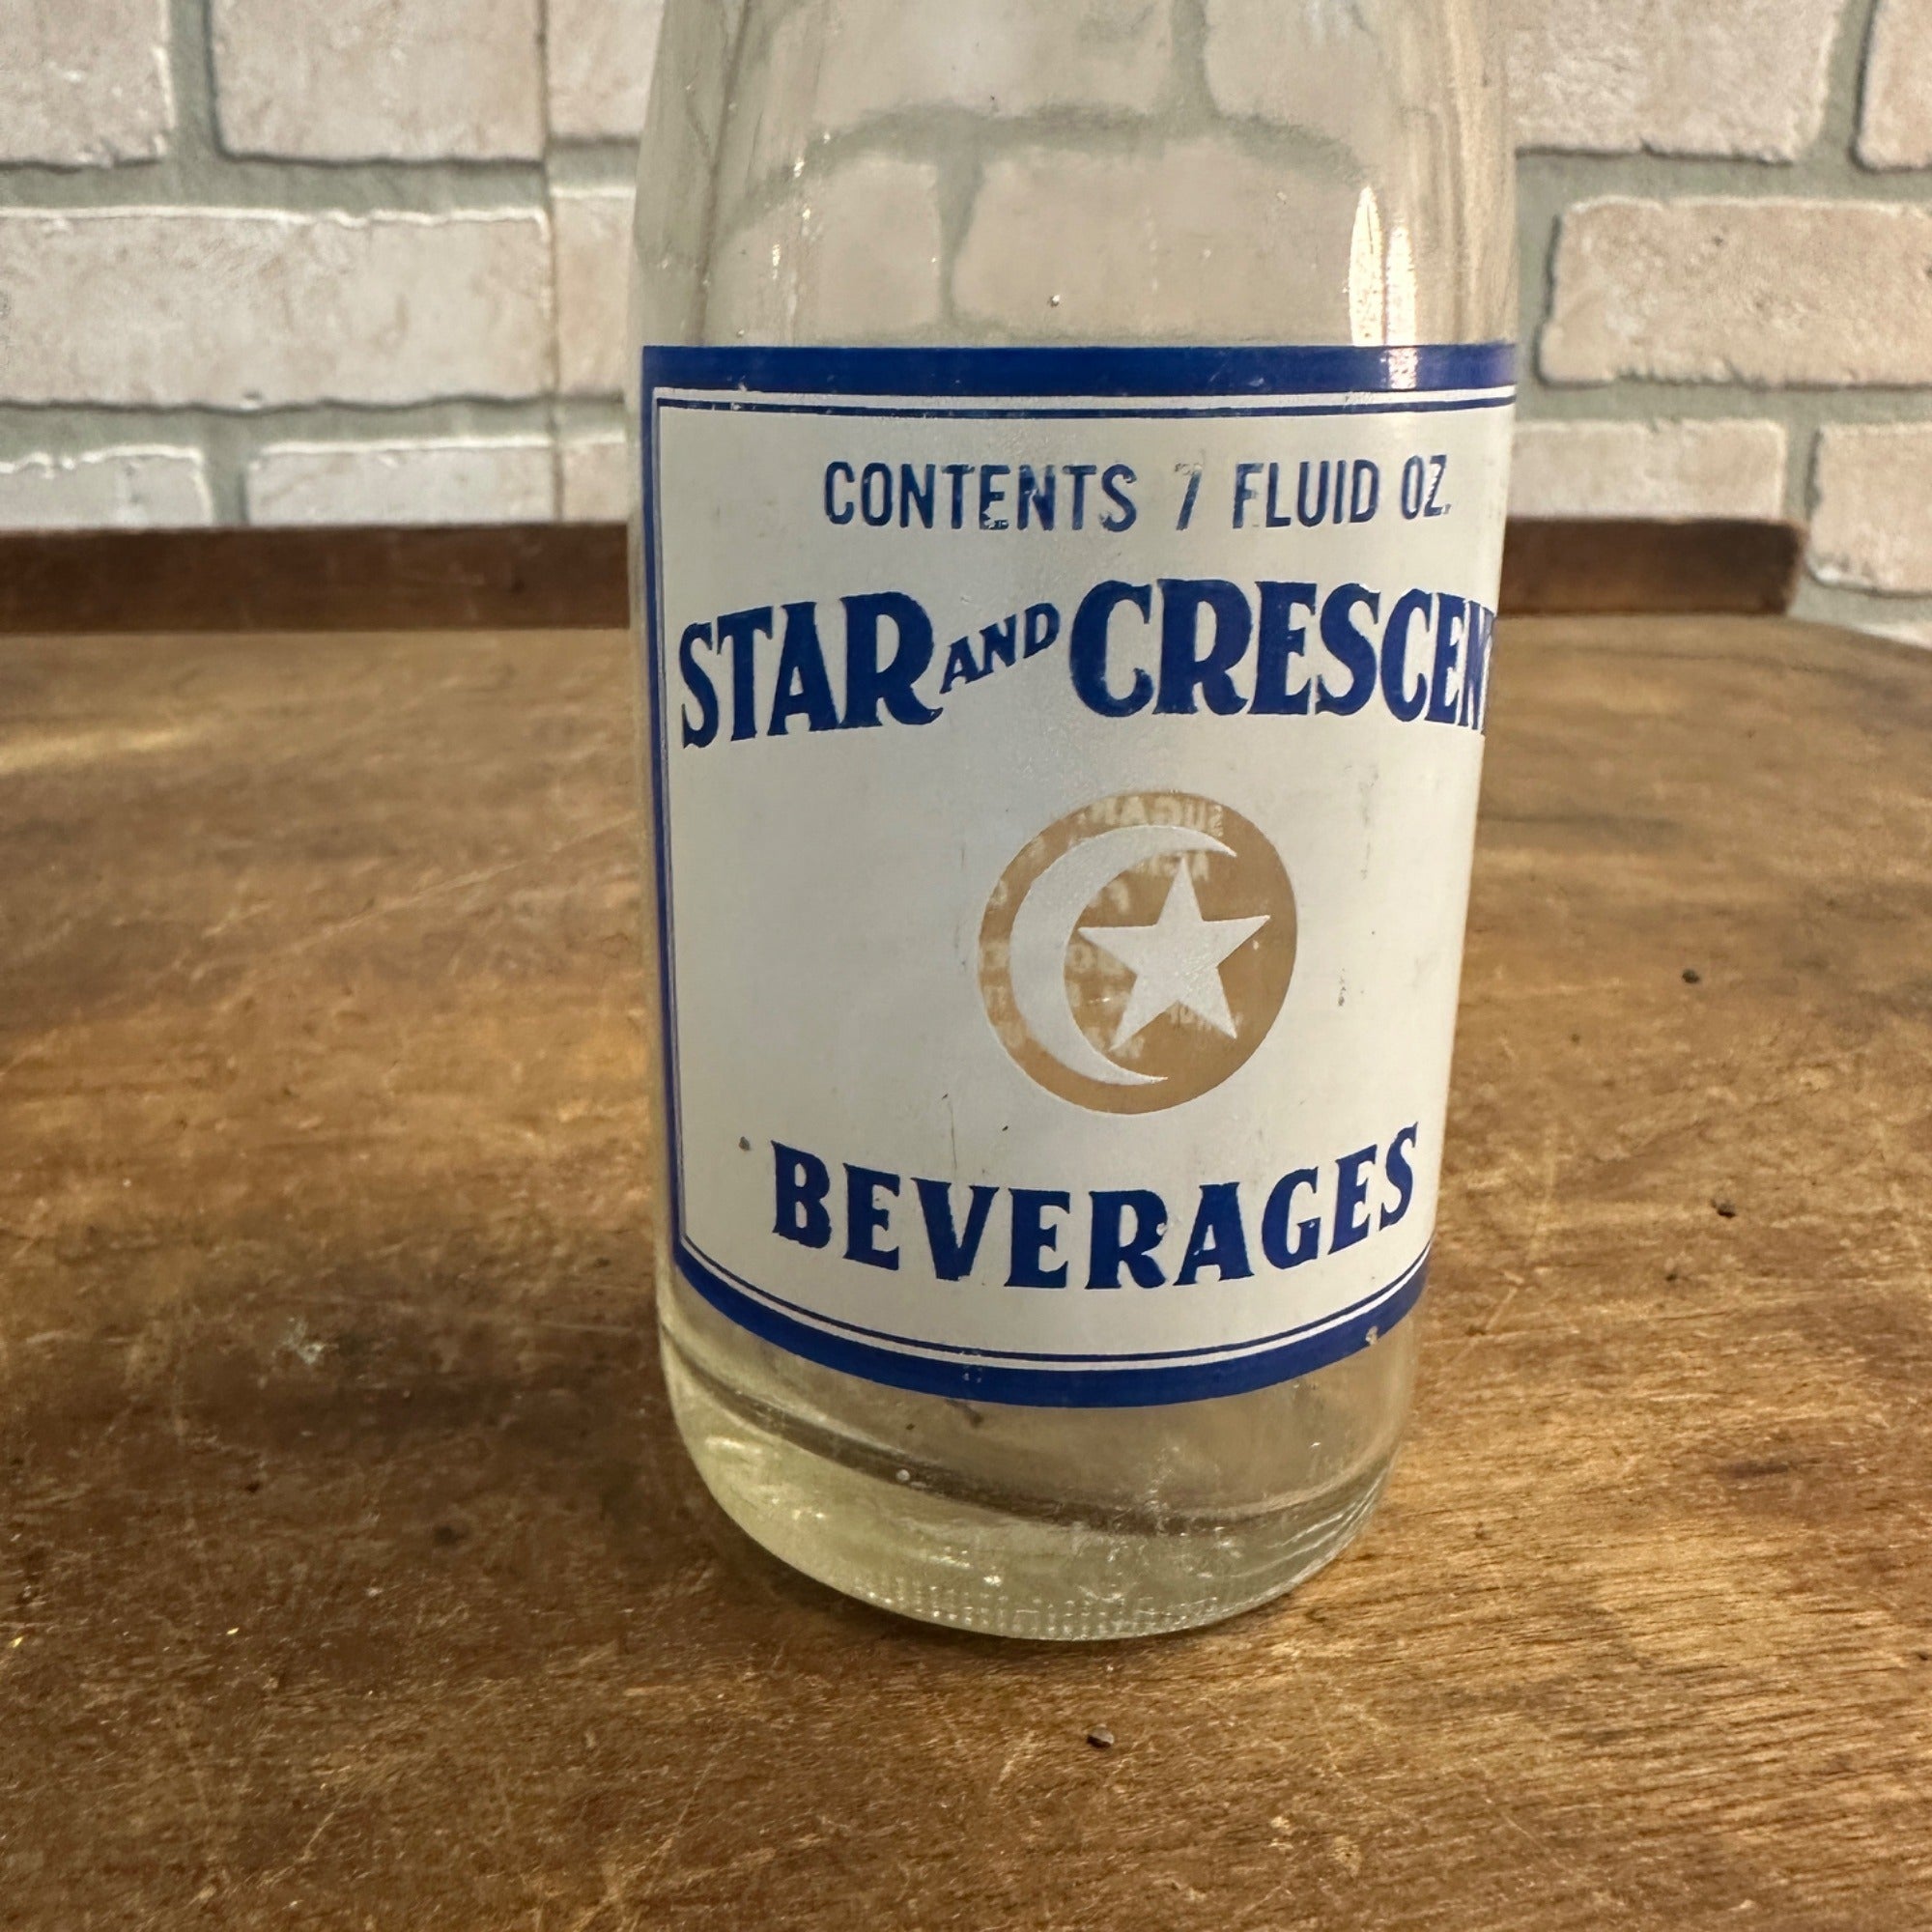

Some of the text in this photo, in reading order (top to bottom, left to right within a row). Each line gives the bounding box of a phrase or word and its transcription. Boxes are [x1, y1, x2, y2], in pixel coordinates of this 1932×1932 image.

[824, 461, 1137, 532] CONTENTS
[1173, 461, 1204, 531] 7
[1233, 458, 1379, 529] FLUID
[679, 591, 943, 749] STAR
[939, 602, 1061, 695] AND
[771, 1122, 1418, 1291] BEVERAGES
